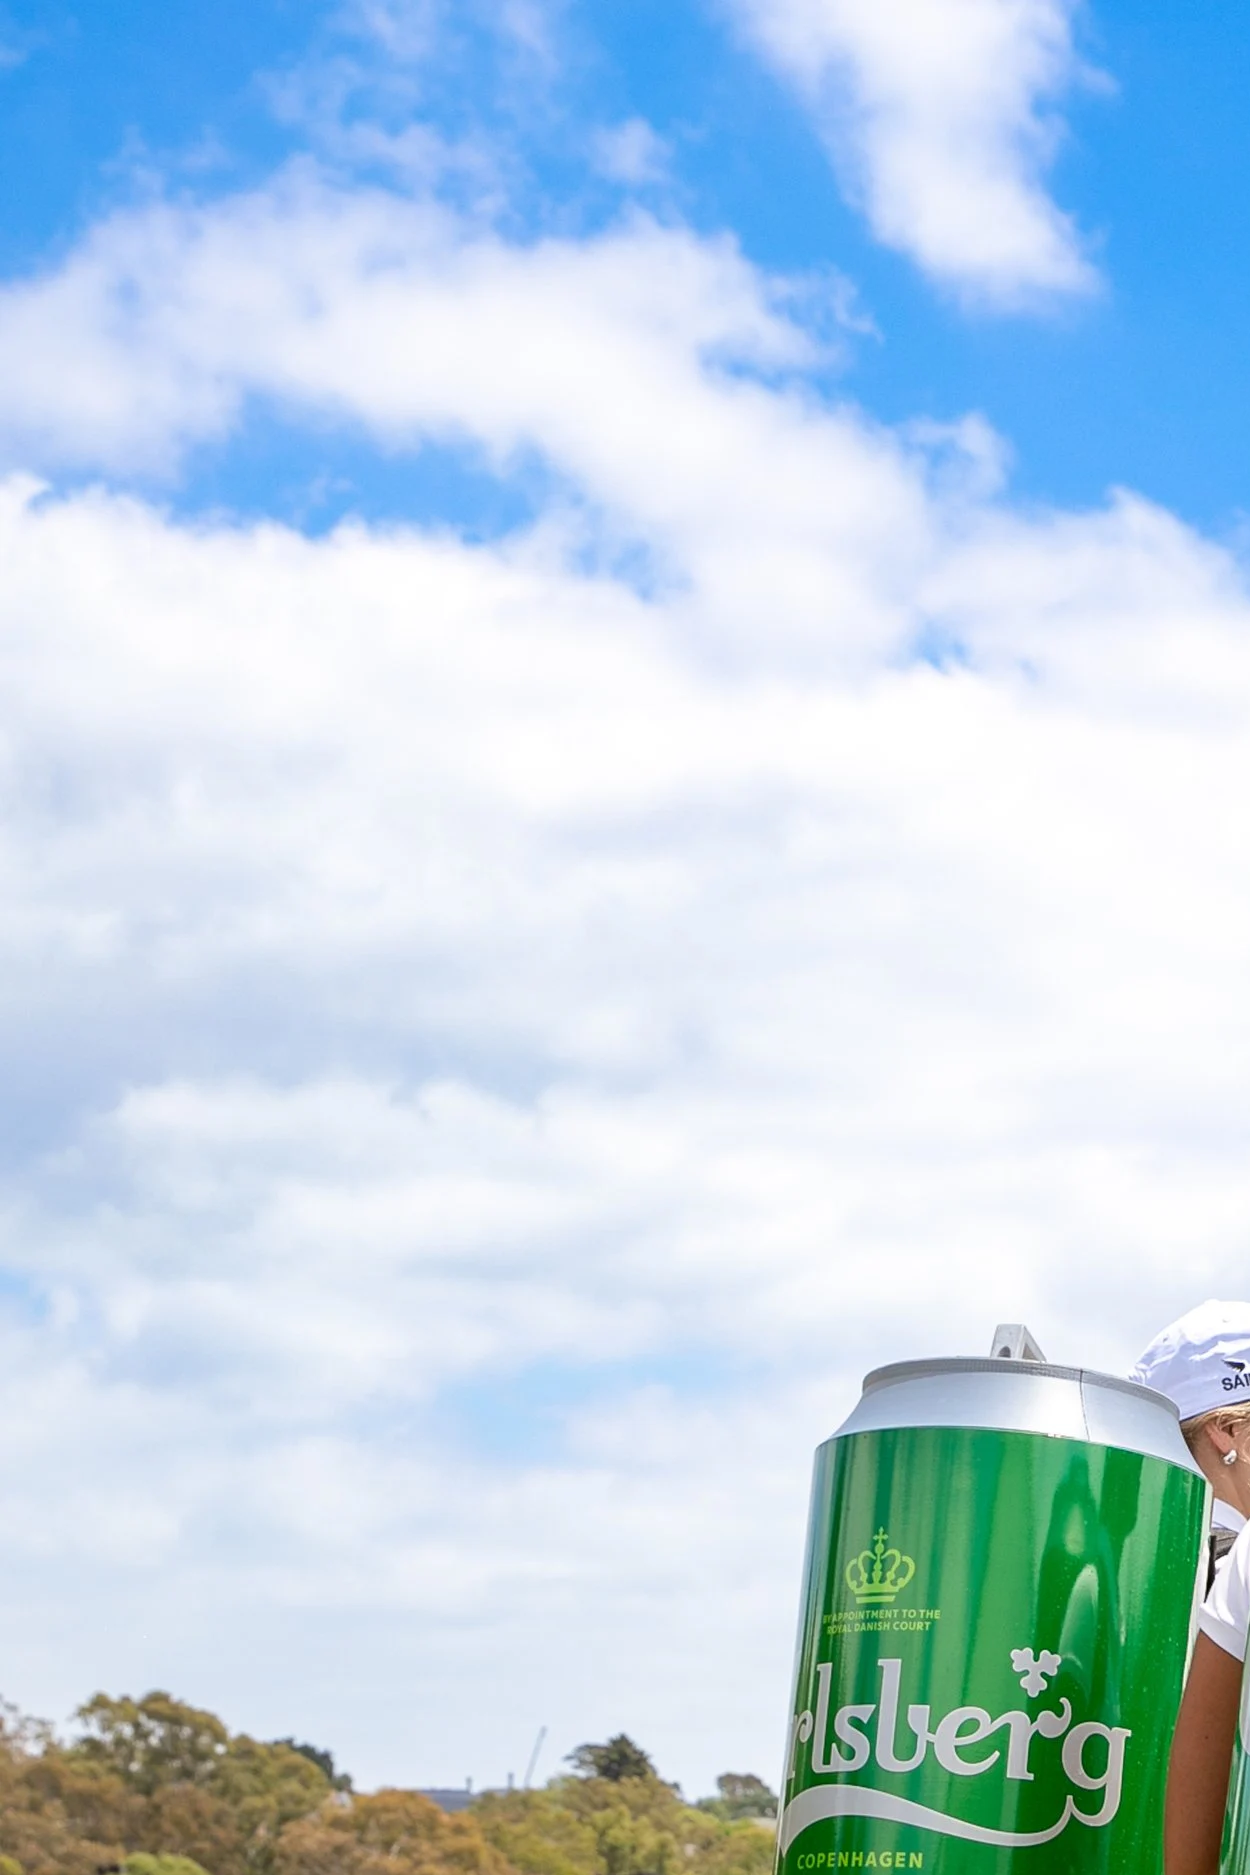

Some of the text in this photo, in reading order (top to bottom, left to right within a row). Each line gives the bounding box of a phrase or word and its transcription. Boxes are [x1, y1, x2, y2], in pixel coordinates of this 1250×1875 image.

[832, 1609, 899, 1622] APPOINTMENT
[901, 1609, 917, 1619] TO
[919, 1609, 941, 1620] THE
[827, 1621, 932, 1635] ROYAL DANISH COURT
[797, 1851, 923, 1870] COPENHAGEN
